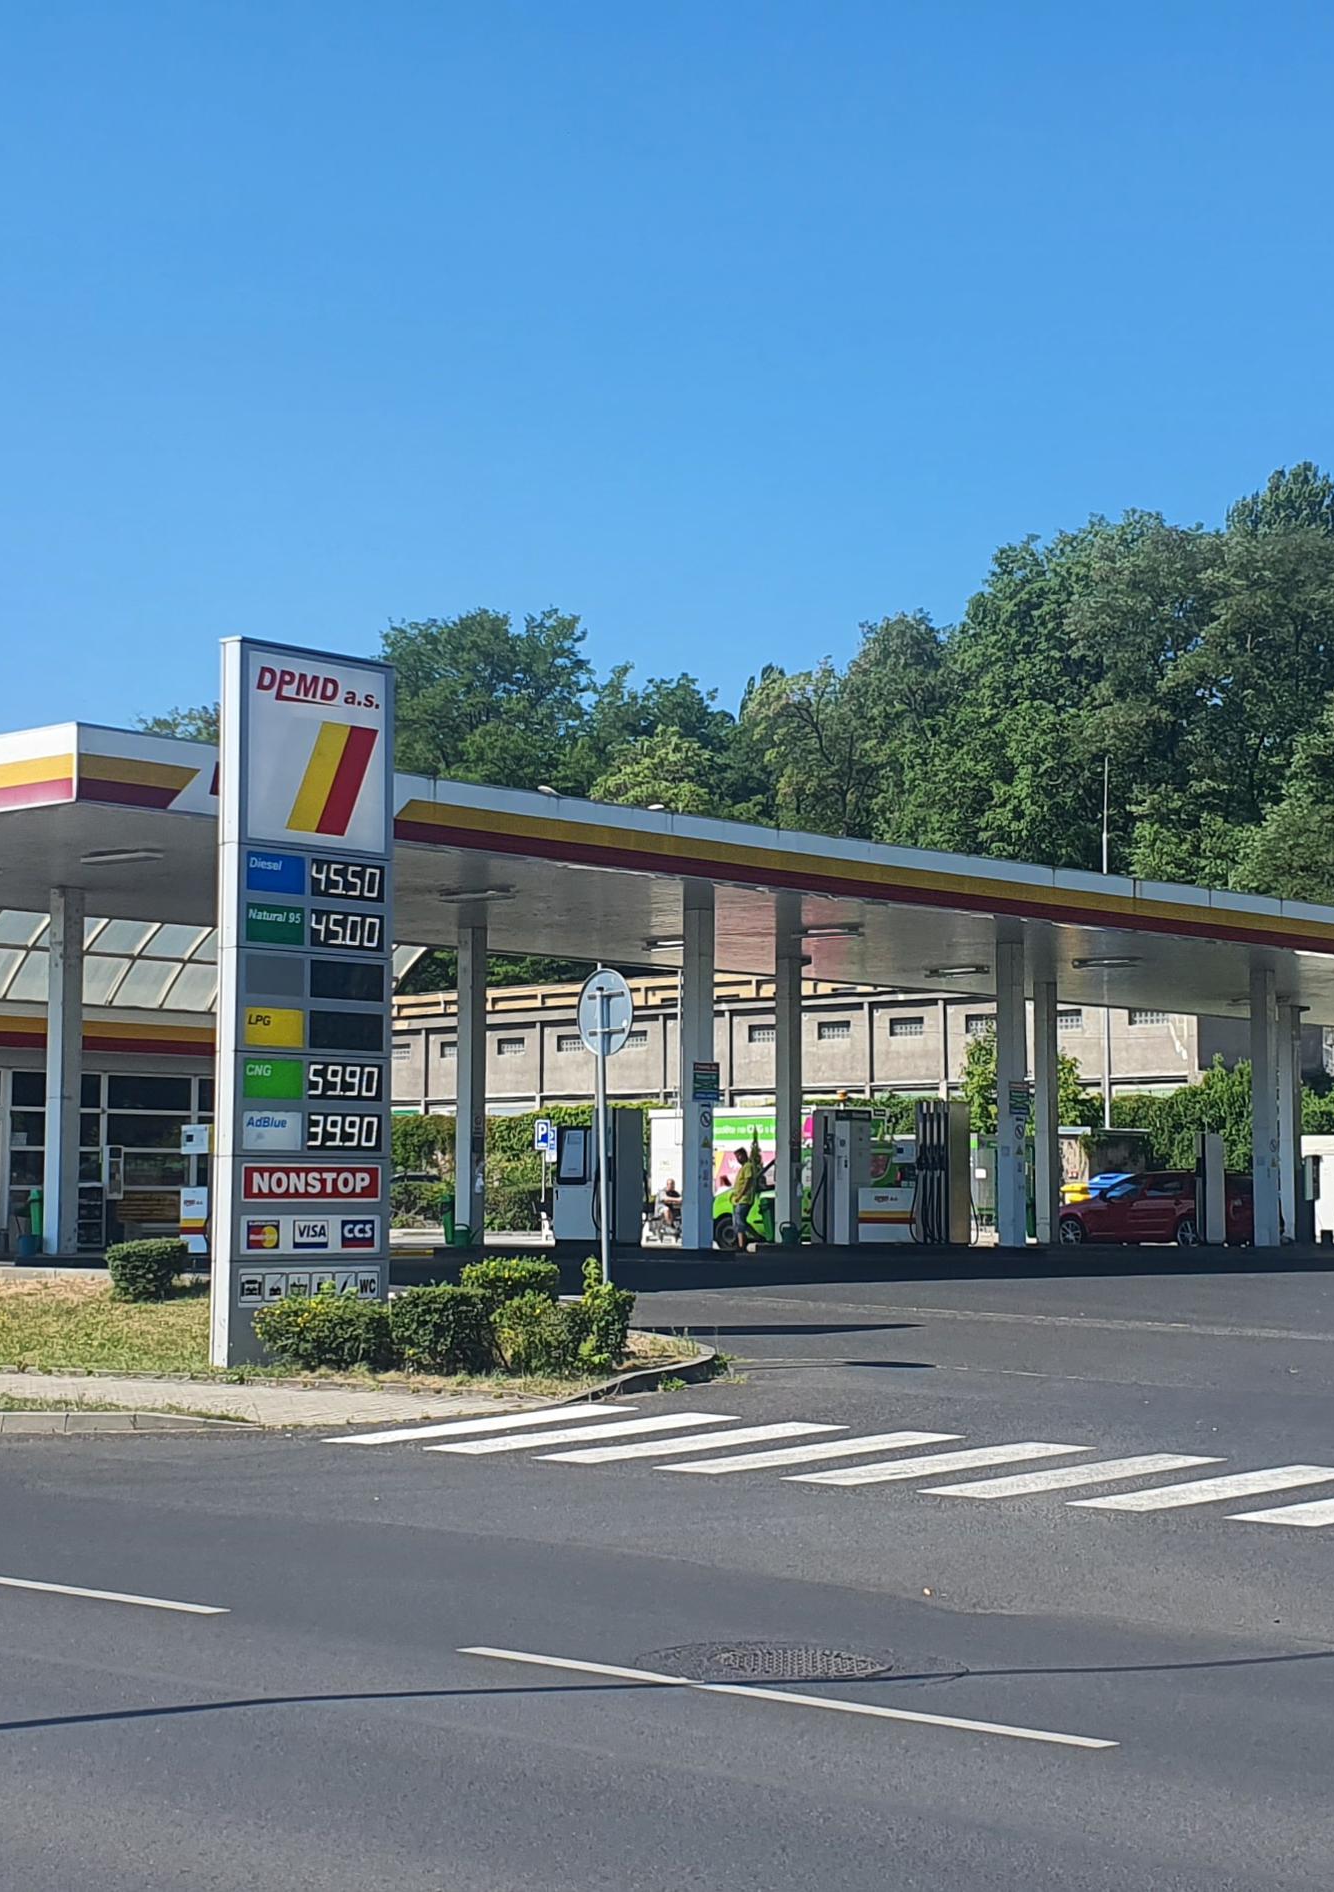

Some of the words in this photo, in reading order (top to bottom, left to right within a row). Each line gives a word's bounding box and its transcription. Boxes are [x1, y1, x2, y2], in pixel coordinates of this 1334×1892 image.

[256, 666, 341, 705] DPMD
[344, 690, 380, 709] a.s.
[249, 857, 283, 871] Diesel
[248, 908, 287, 923] Natural
[288, 912, 302, 924] 95
[248, 1014, 271, 1026] LPG
[246, 1064, 272, 1077] CNG
[246, 1116, 287, 1129] AdBlue
[252, 1172, 370, 1194] NONSTOP
[298, 1224, 327, 1238] VISA
[343, 1224, 373, 1238] CCS
[359, 1279, 376, 1294] WC
